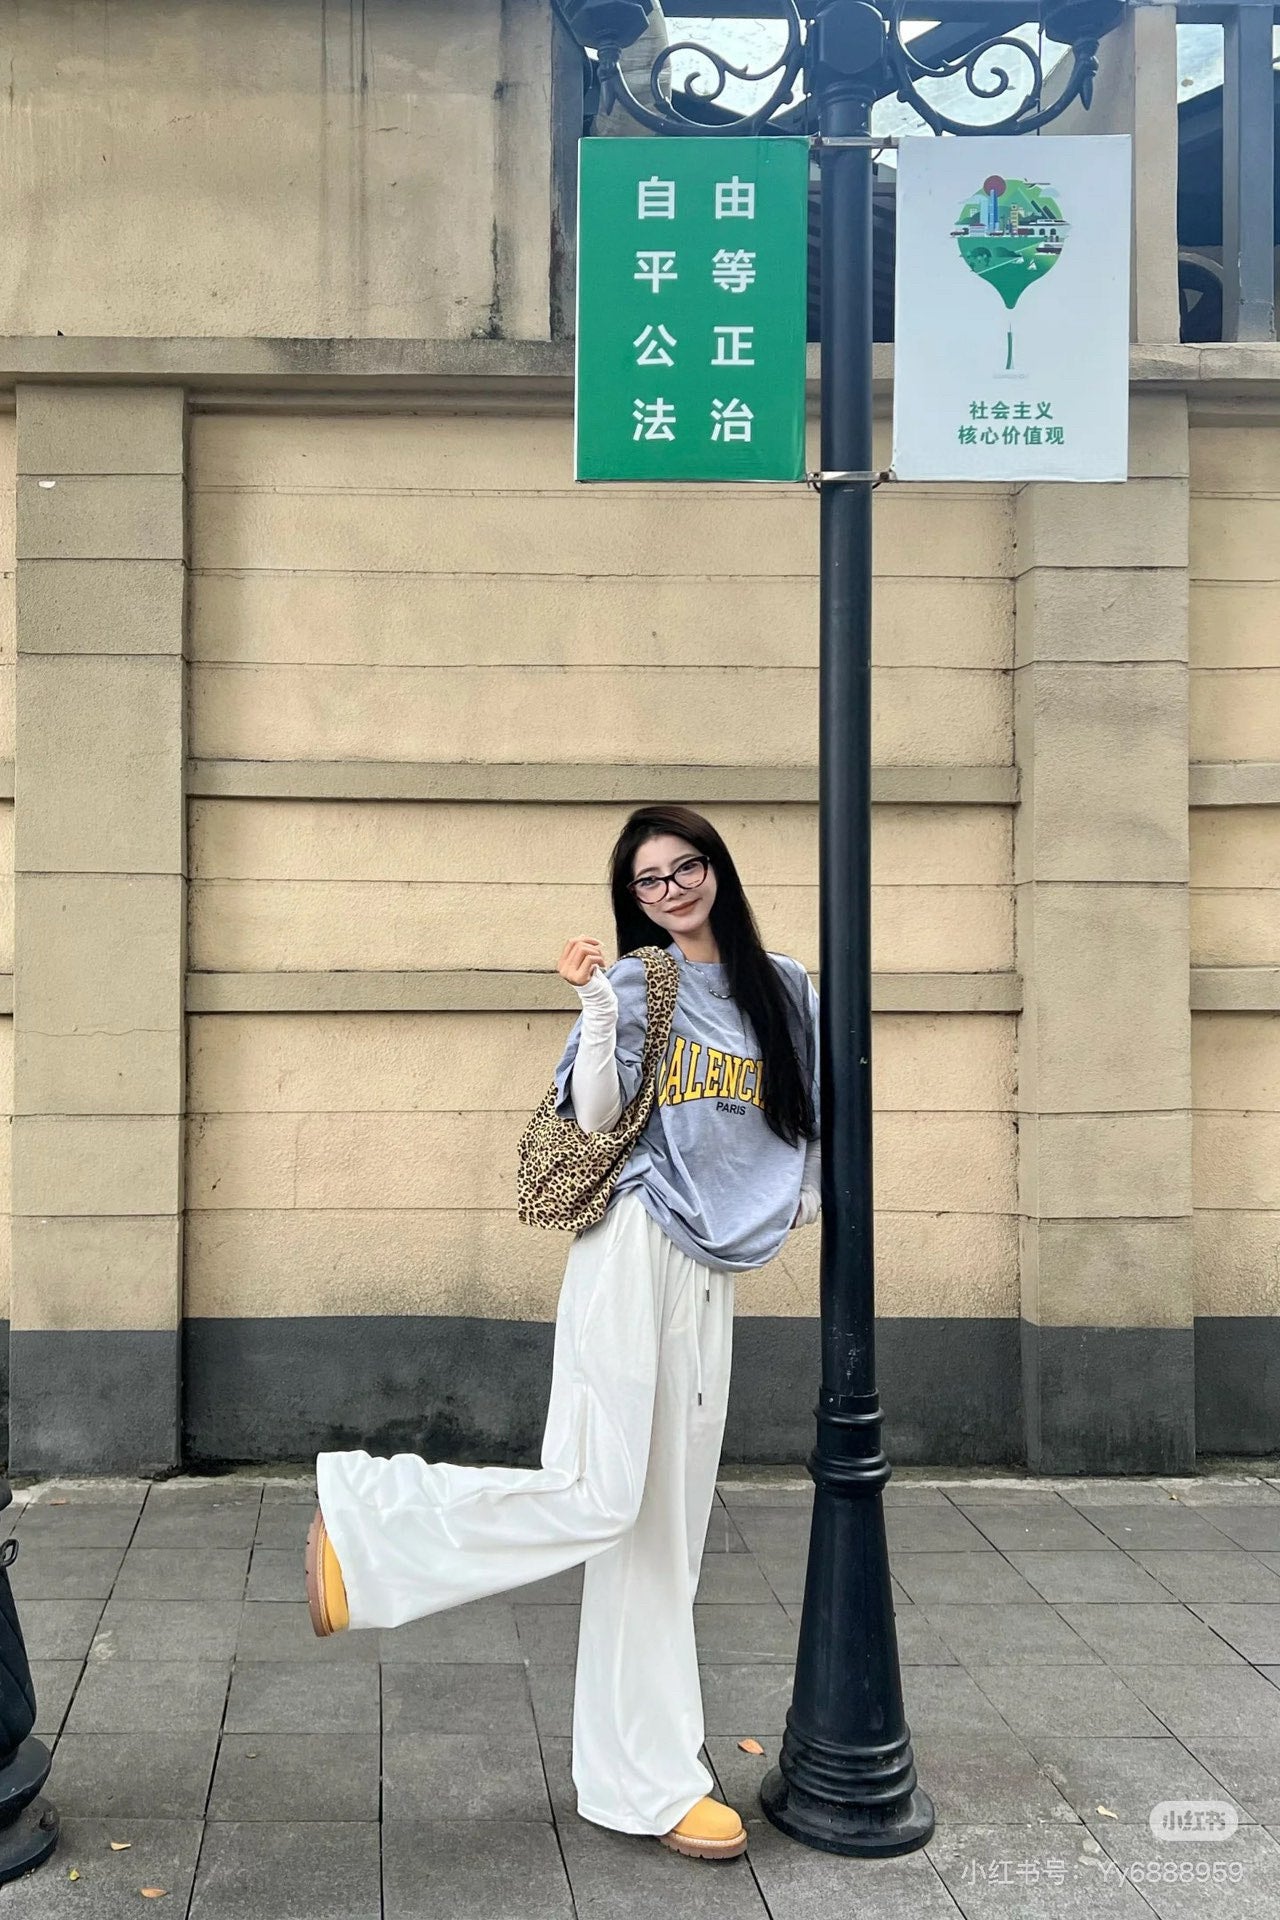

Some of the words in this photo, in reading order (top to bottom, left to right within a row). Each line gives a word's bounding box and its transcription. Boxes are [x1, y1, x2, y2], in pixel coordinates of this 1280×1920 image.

[637, 175, 755, 220] 自由
[633, 249, 756, 294] 平等
[632, 324, 755, 367] 公正
[631, 397, 754, 442] 法治
[969, 400, 1054, 421] 社会主义
[957, 425, 1065, 446] 核心价值观
[716, 1101, 746, 1116] PARIS
